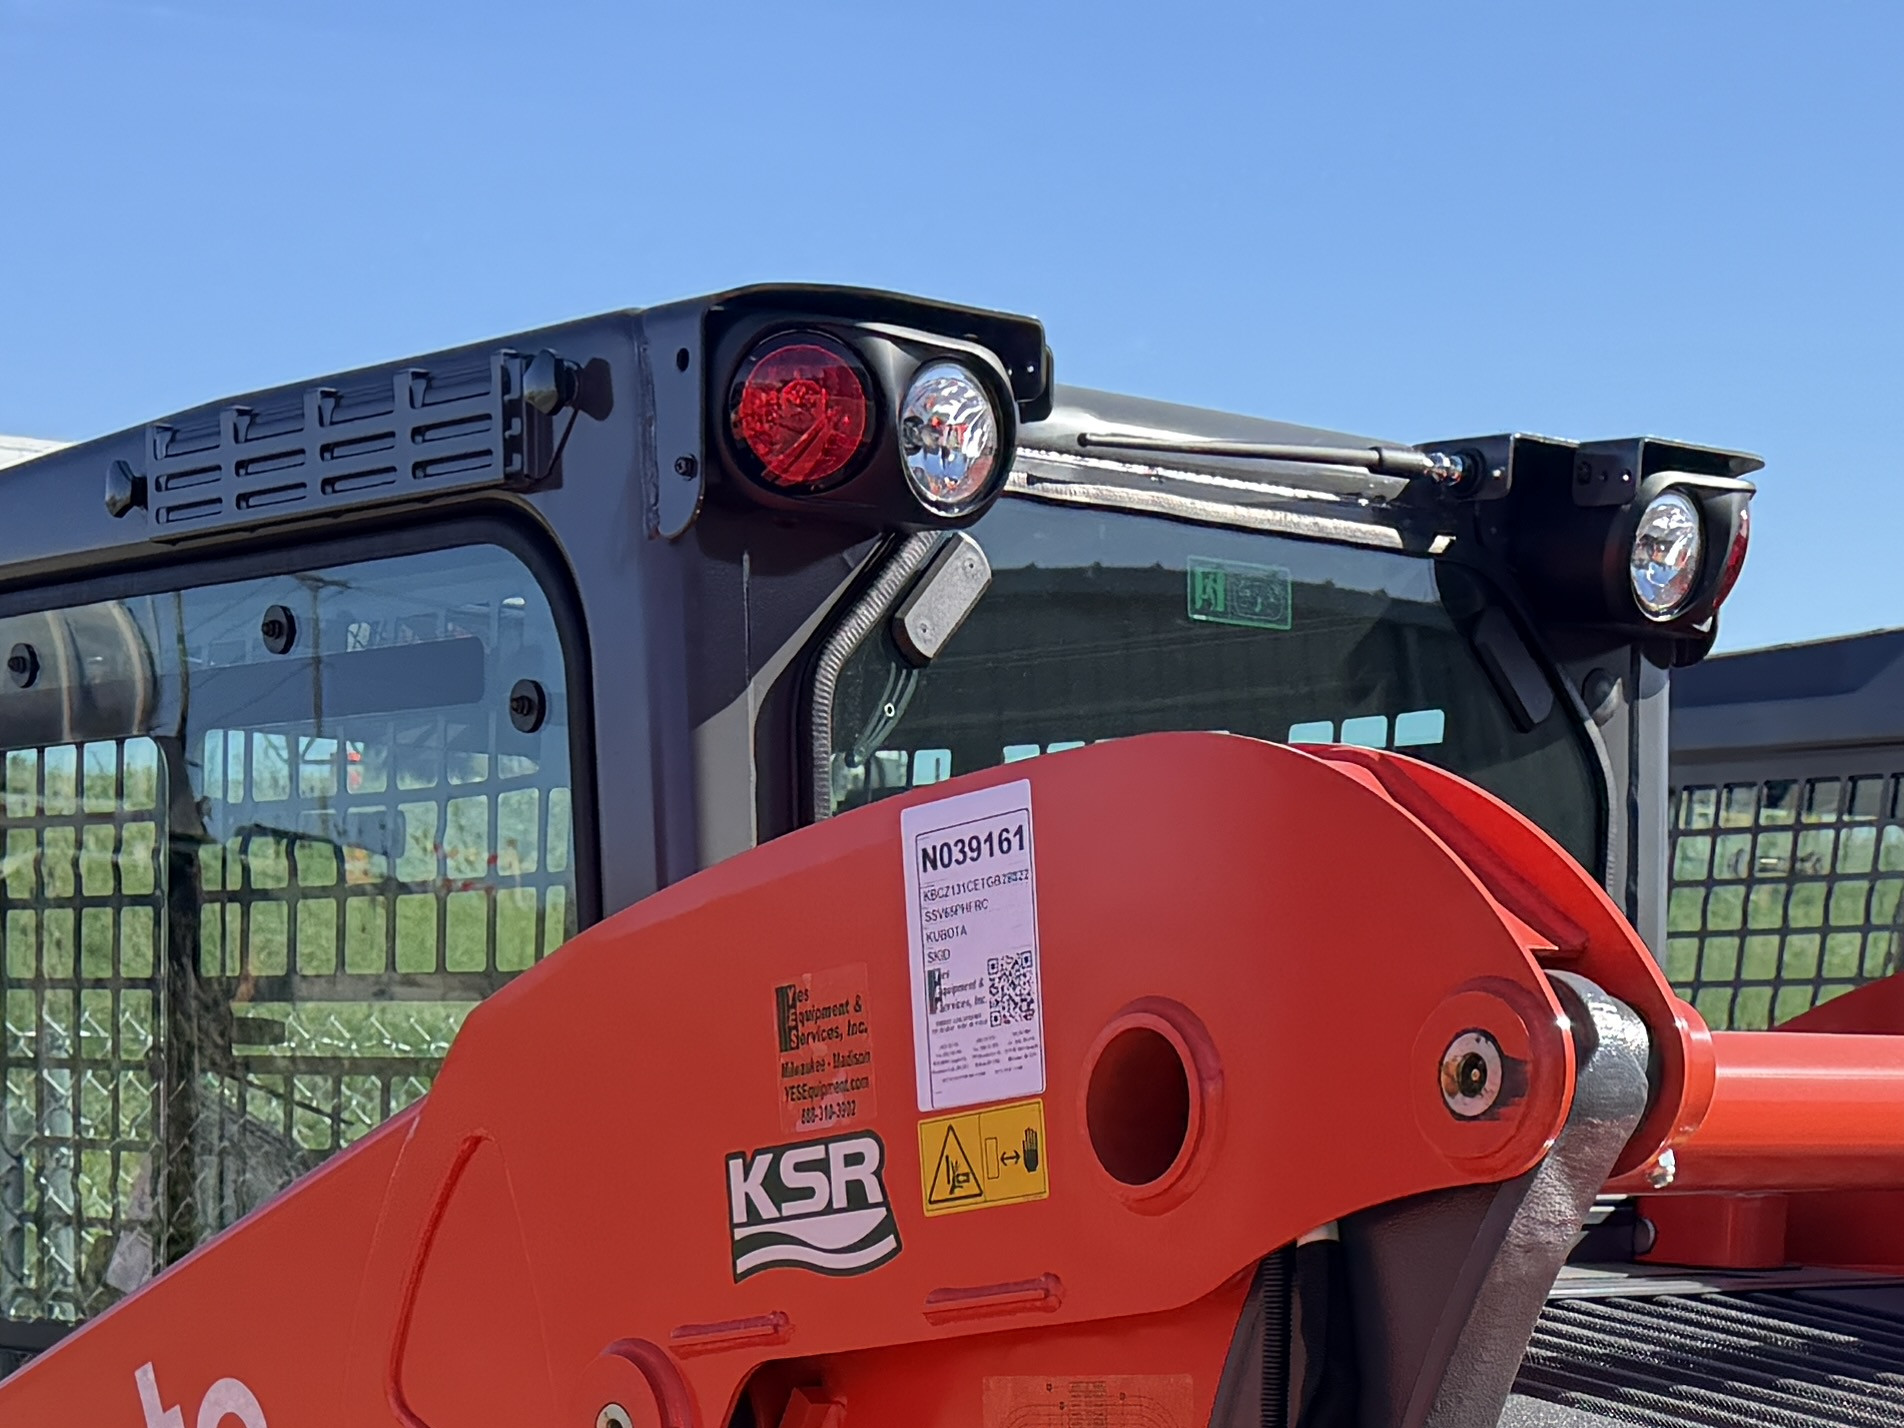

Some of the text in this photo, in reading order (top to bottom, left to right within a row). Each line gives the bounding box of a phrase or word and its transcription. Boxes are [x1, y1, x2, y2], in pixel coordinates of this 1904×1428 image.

[921, 824, 1026, 874] N039161
[926, 925, 968, 944] KUBOTA
[787, 994, 862, 1027] Equipment &
[789, 1019, 868, 1048] Services, Inc.
[728, 1136, 885, 1225] KSR
